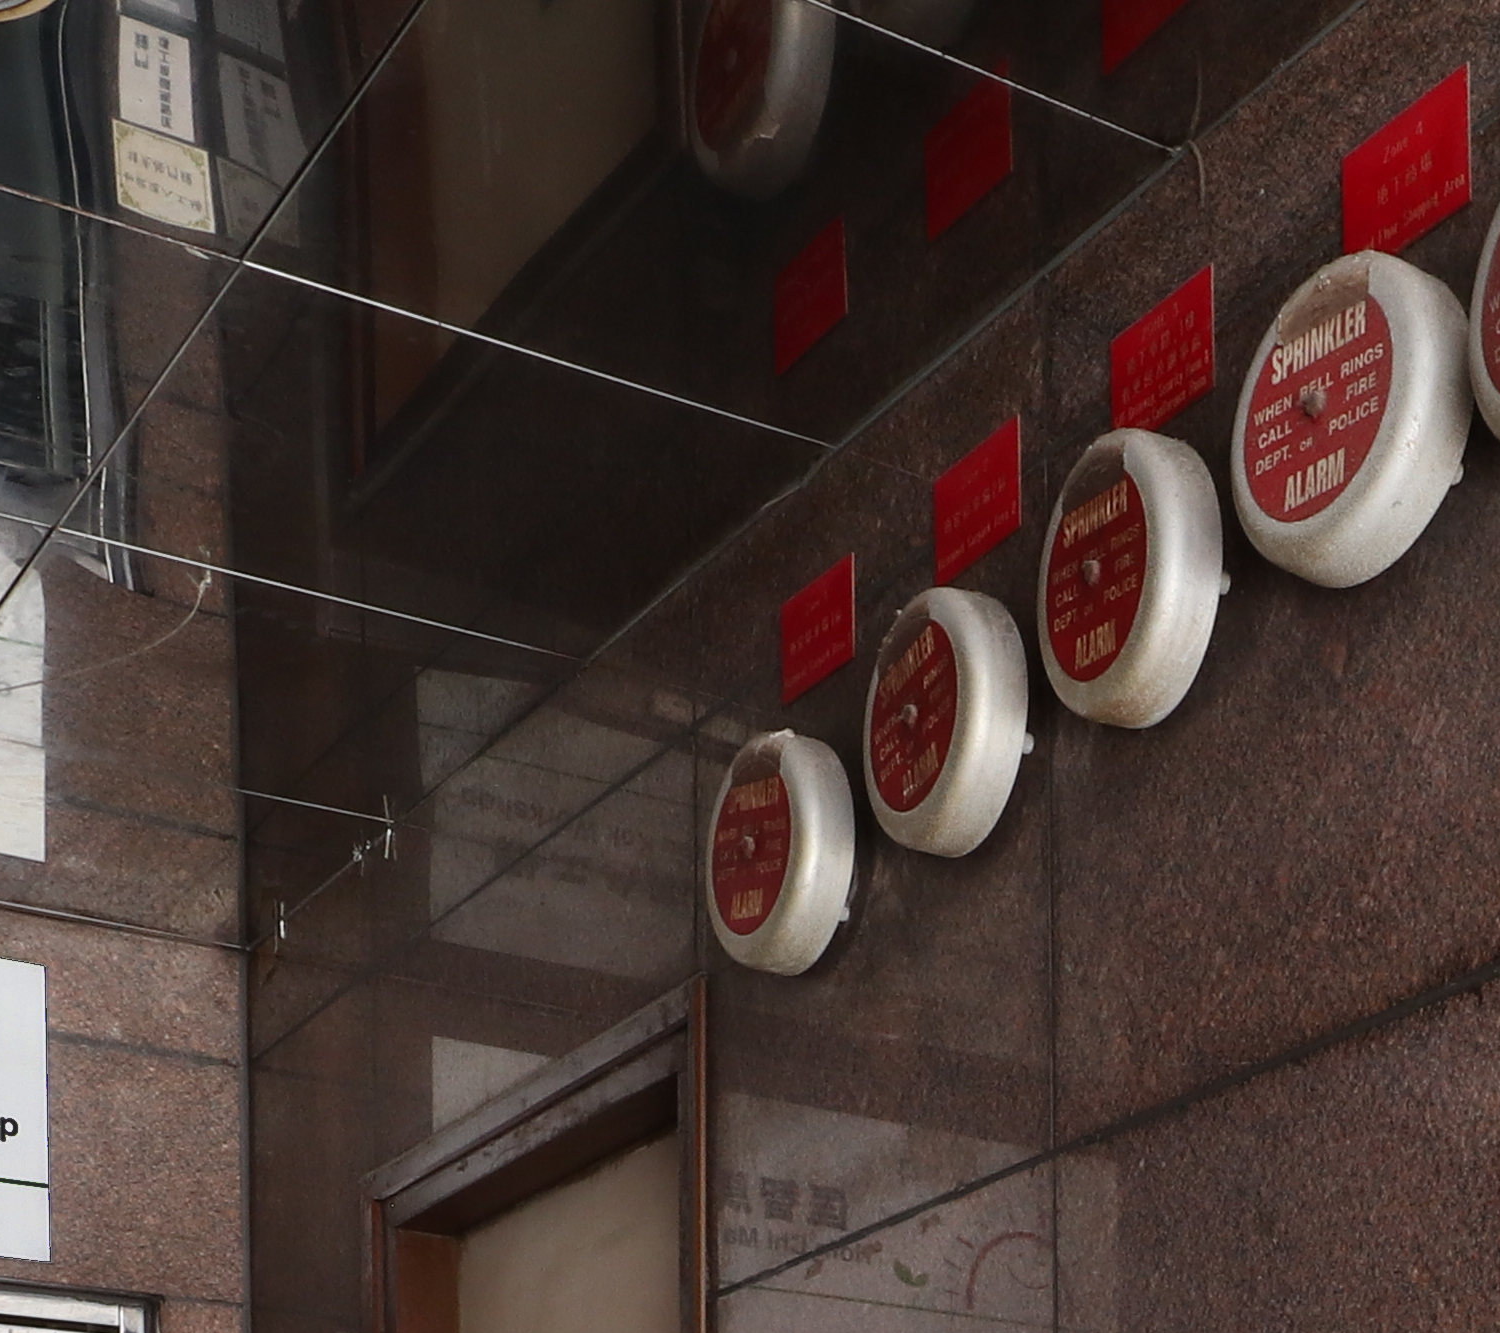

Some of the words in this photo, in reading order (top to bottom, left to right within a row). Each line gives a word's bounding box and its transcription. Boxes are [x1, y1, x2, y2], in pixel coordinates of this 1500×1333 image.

[1443, 173, 1466, 198] Area
[1271, 299, 1368, 387] SPRINKLER
[1253, 393, 1294, 427] WHEN
[1339, 342, 1385, 380] RINGS
[1257, 420, 1293, 450] CALL
[1345, 371, 1378, 402] FIRE
[1255, 444, 1293, 477] DEPT.
[1299, 436, 1314, 452] OR
[1328, 395, 1380, 437] POLICE
[1283, 446, 1347, 513] ALARM
[1062, 479, 1129, 550] SPRINKLER
[1054, 584, 1080, 609] CALL
[1102, 573, 1139, 605] POLICE
[1074, 618, 1117, 672] ALARM
